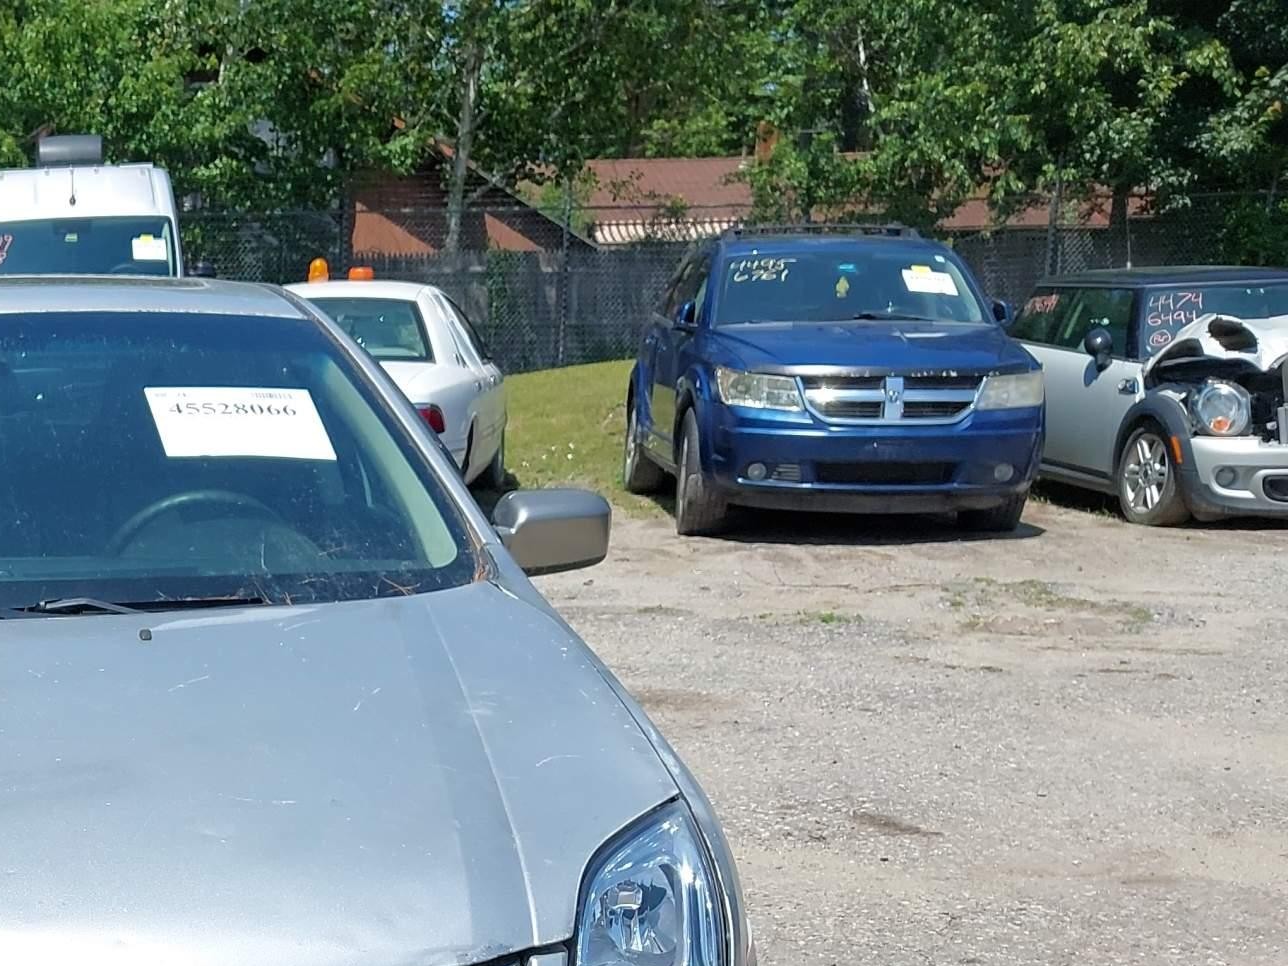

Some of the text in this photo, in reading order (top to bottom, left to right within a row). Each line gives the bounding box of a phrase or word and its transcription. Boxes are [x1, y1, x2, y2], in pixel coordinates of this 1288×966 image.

[1149, 292, 1203, 312] 4474
[1148, 310, 1197, 326] 6494
[169, 402, 297, 417] 45528066
